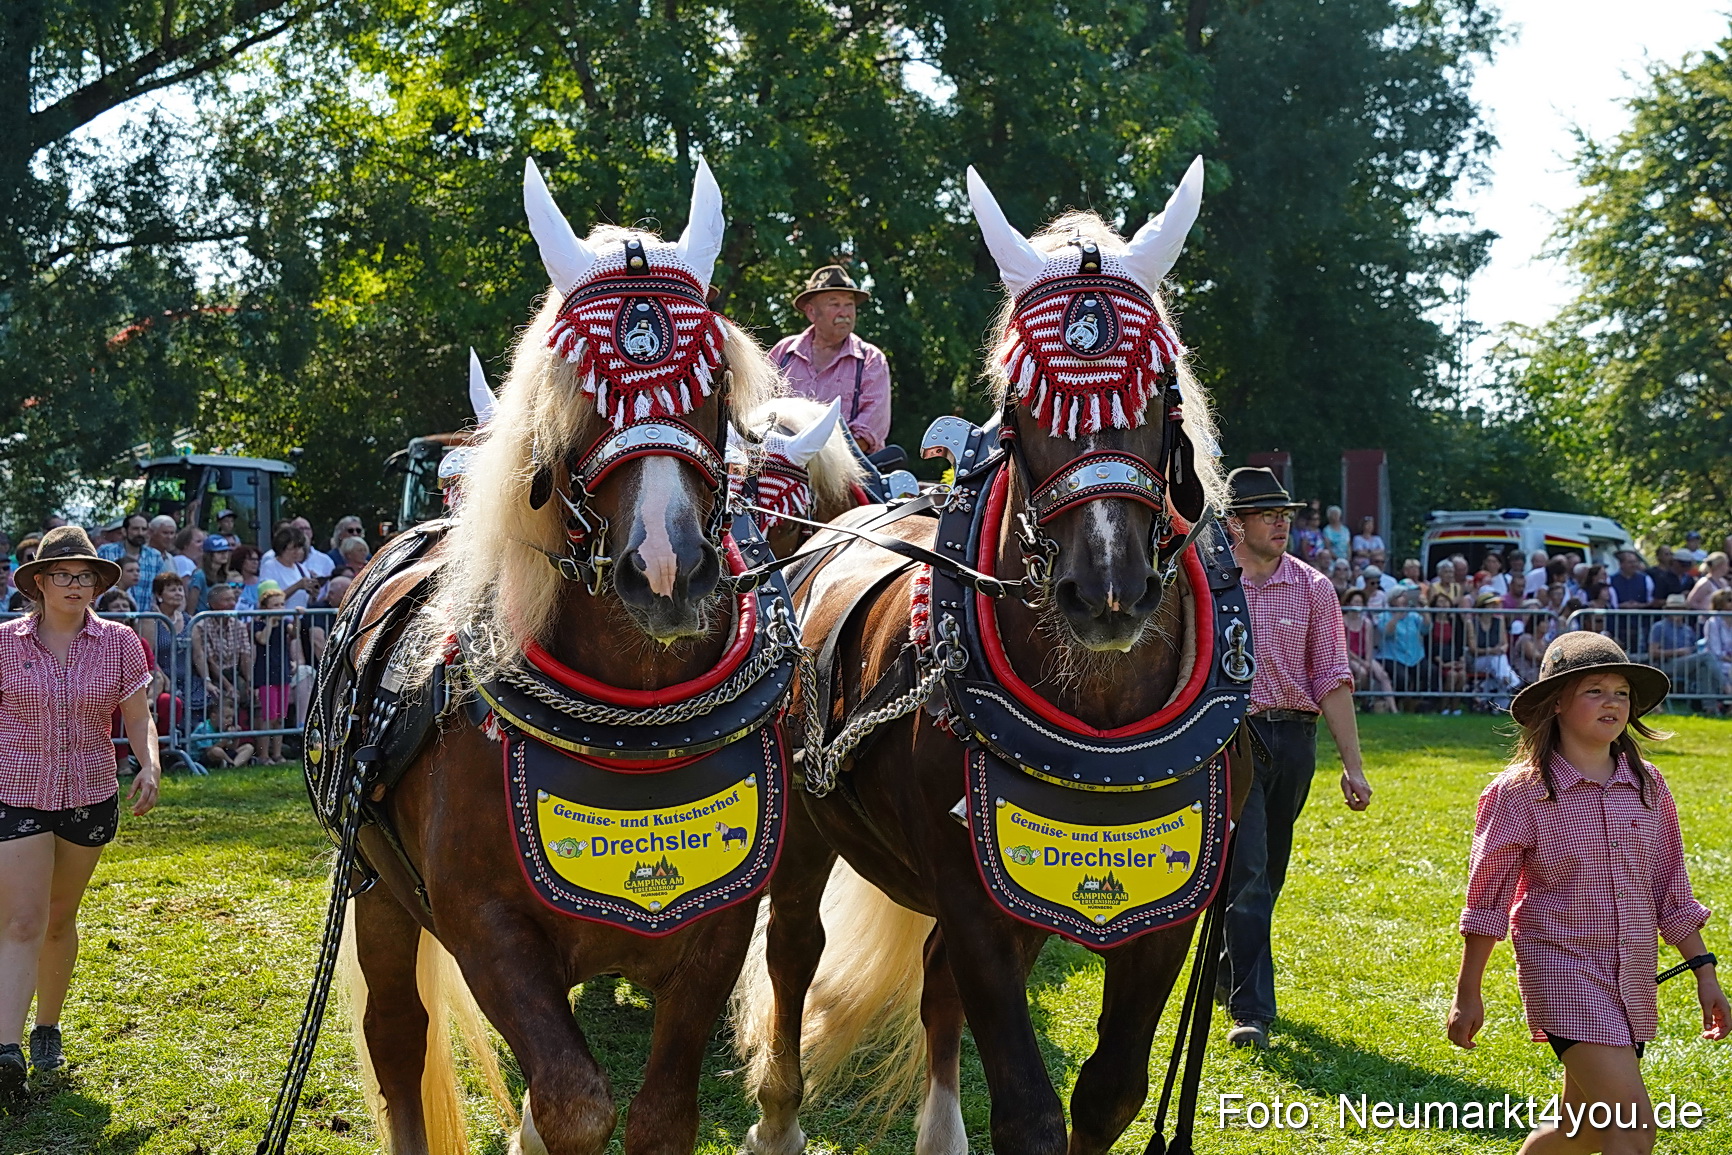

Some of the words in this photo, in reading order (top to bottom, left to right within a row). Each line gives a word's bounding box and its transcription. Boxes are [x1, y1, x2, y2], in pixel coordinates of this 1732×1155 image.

[553, 804, 616, 827] Gemüse-
[620, 815, 649, 828] und
[653, 791, 740, 827] Kutscherhof
[1010, 812, 1068, 838] Gemüse-
[1071, 830, 1099, 842] und
[1102, 815, 1185, 842] Kutscherhof
[591, 830, 712, 857] Drechsler
[1044, 846, 1157, 868] Drechsler
[625, 878, 668, 888] CAMPING
[669, 877, 683, 885] AM
[1073, 892, 1113, 900] CAMPING
